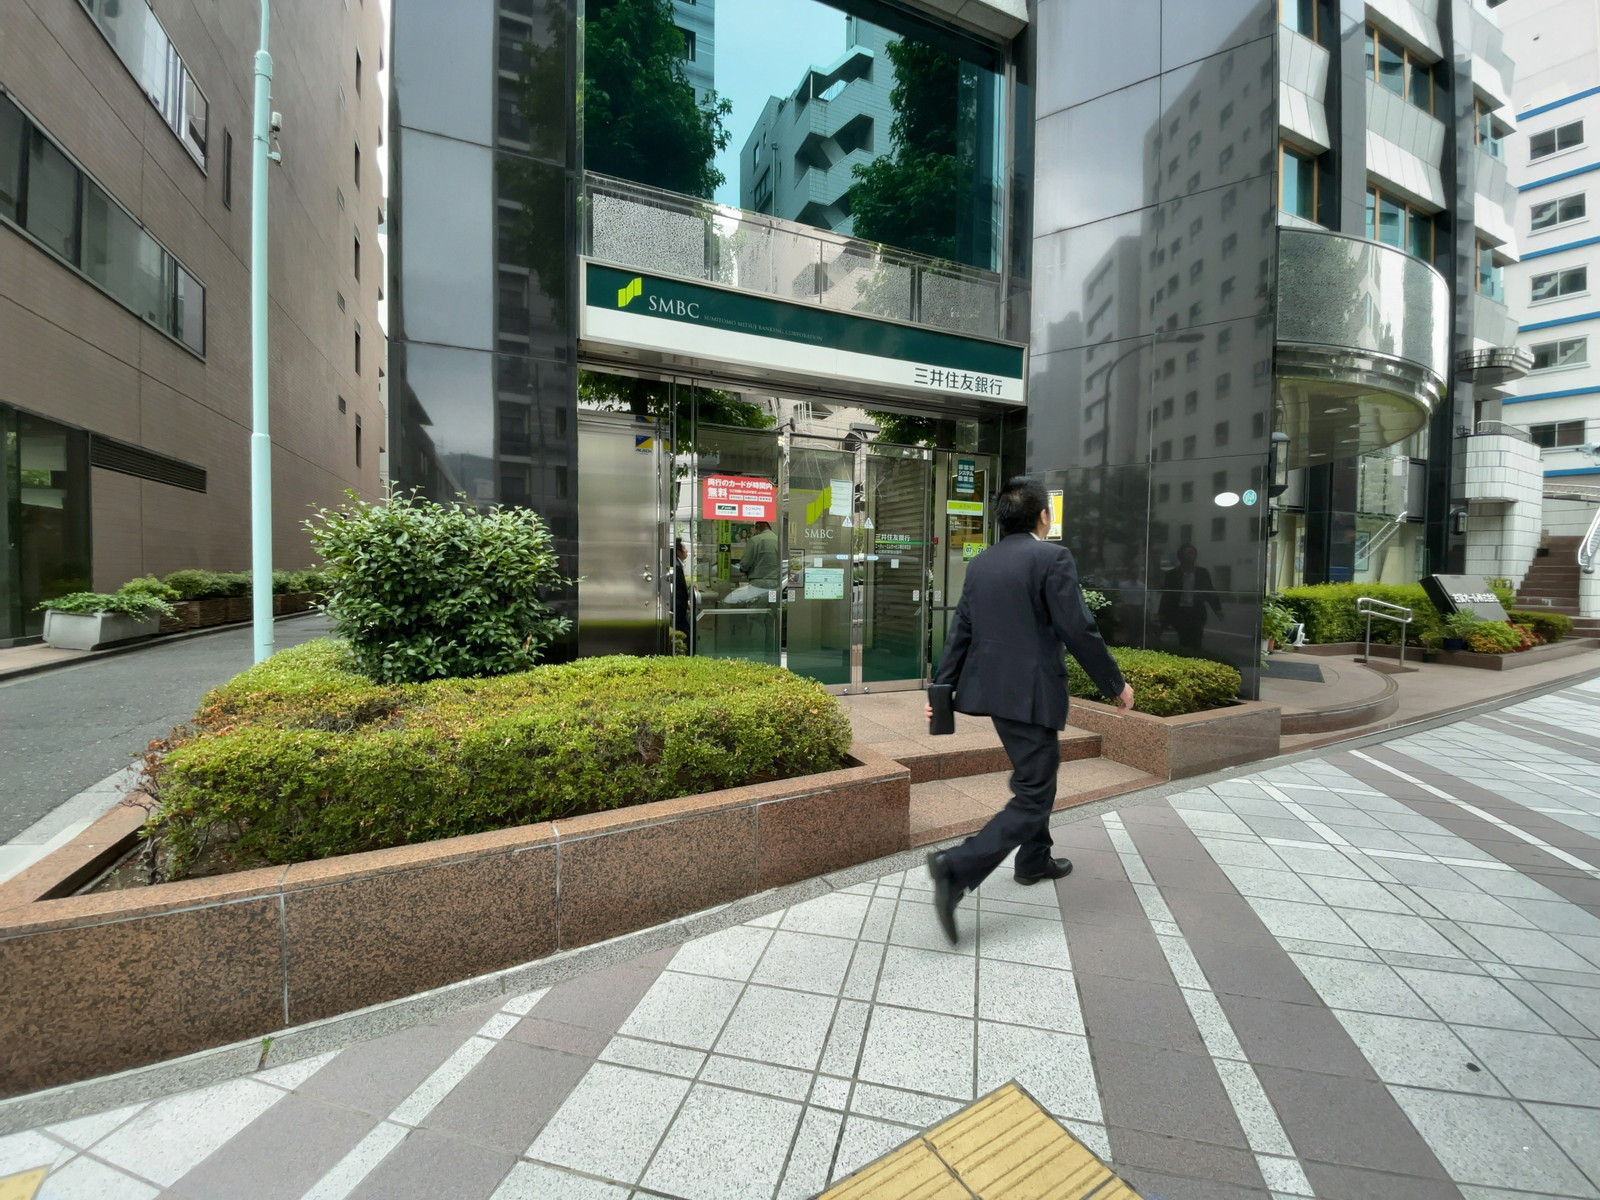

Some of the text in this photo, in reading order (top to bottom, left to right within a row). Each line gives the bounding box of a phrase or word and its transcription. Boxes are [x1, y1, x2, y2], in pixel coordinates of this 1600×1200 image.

[648, 295, 823, 341] SMBC SUMITOMO MITSUI BANKING CORPORATION
[914, 367, 1003, 396] 三井住友銀行
[708, 487, 727, 498] 無料
[804, 528, 834, 539] SMBC
[875, 533, 910, 542] 三井住友銀行
